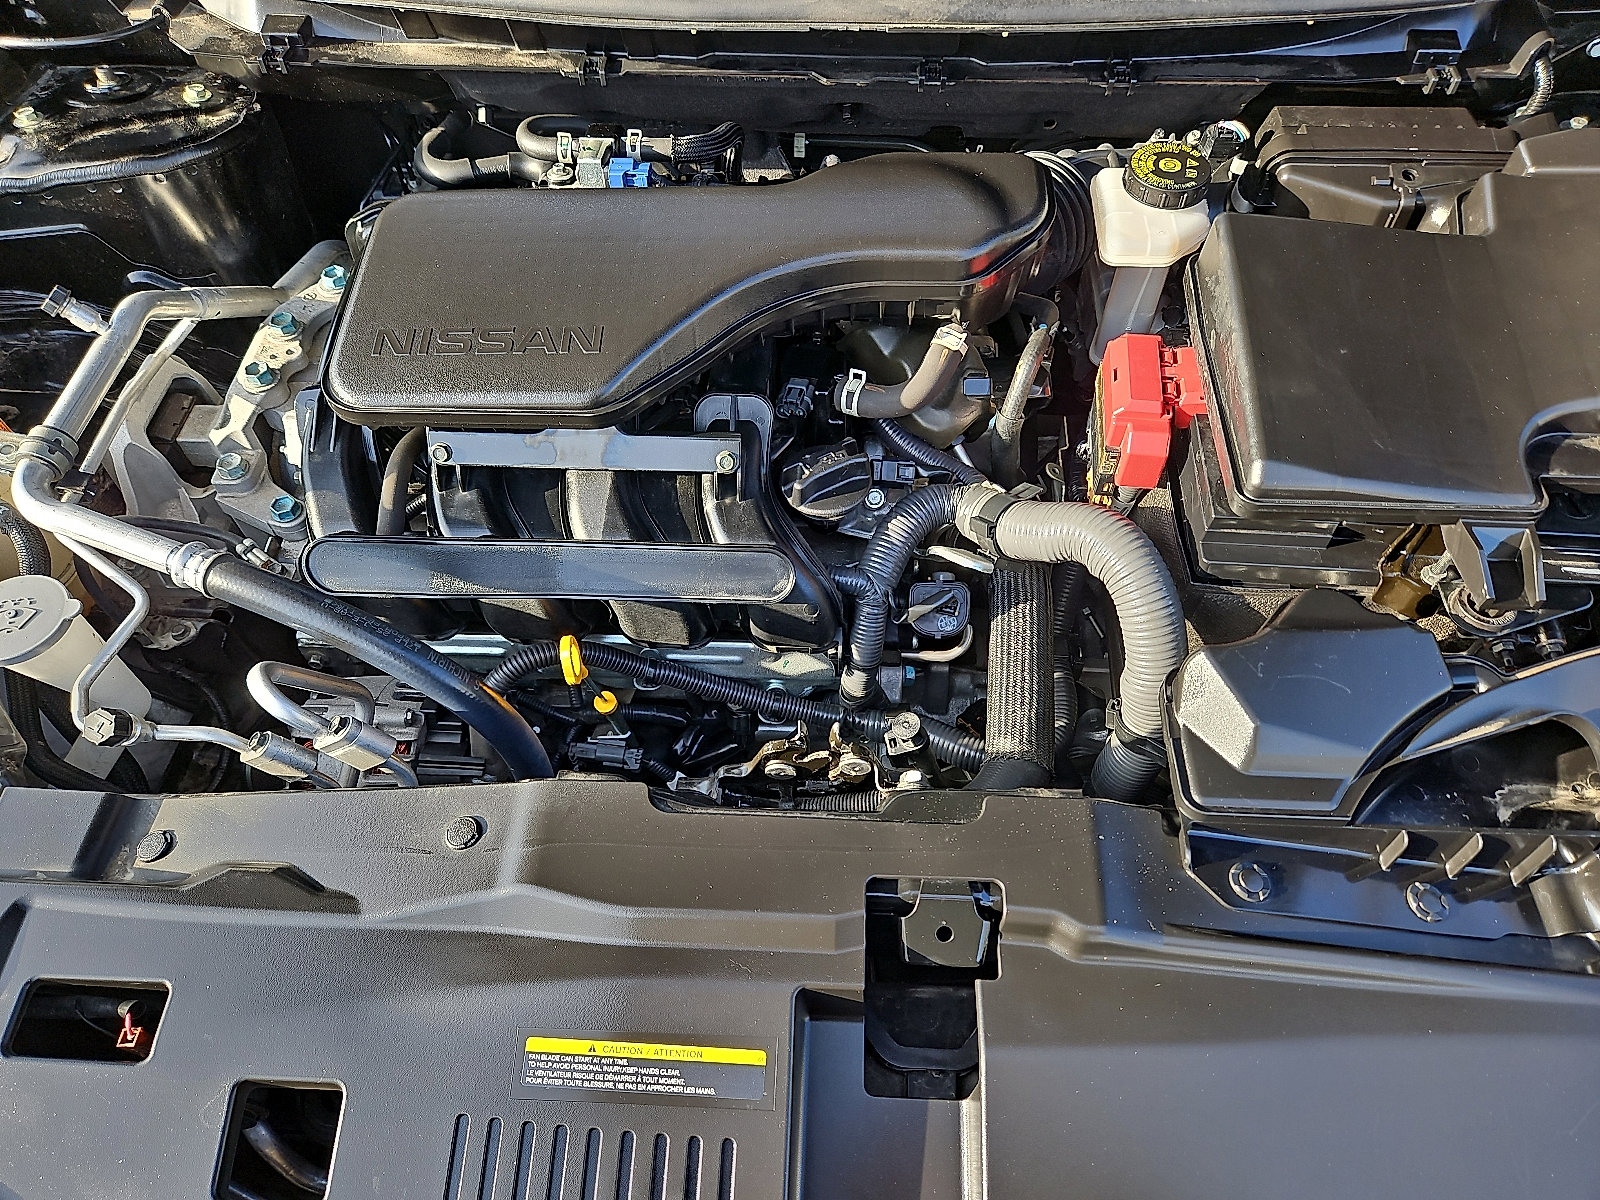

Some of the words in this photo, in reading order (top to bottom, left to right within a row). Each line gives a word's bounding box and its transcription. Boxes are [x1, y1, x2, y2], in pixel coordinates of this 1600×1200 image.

[371, 325, 605, 356] NISSAN
[602, 1045, 643, 1054] CAUTION
[654, 1048, 703, 1059] ATTENTION
[535, 1070, 572, 1078] VENTILATEUR
[572, 1072, 594, 1080] RISQUE
[639, 1067, 659, 1075] HANDS
[646, 1084, 683, 1093] APPROCHER
